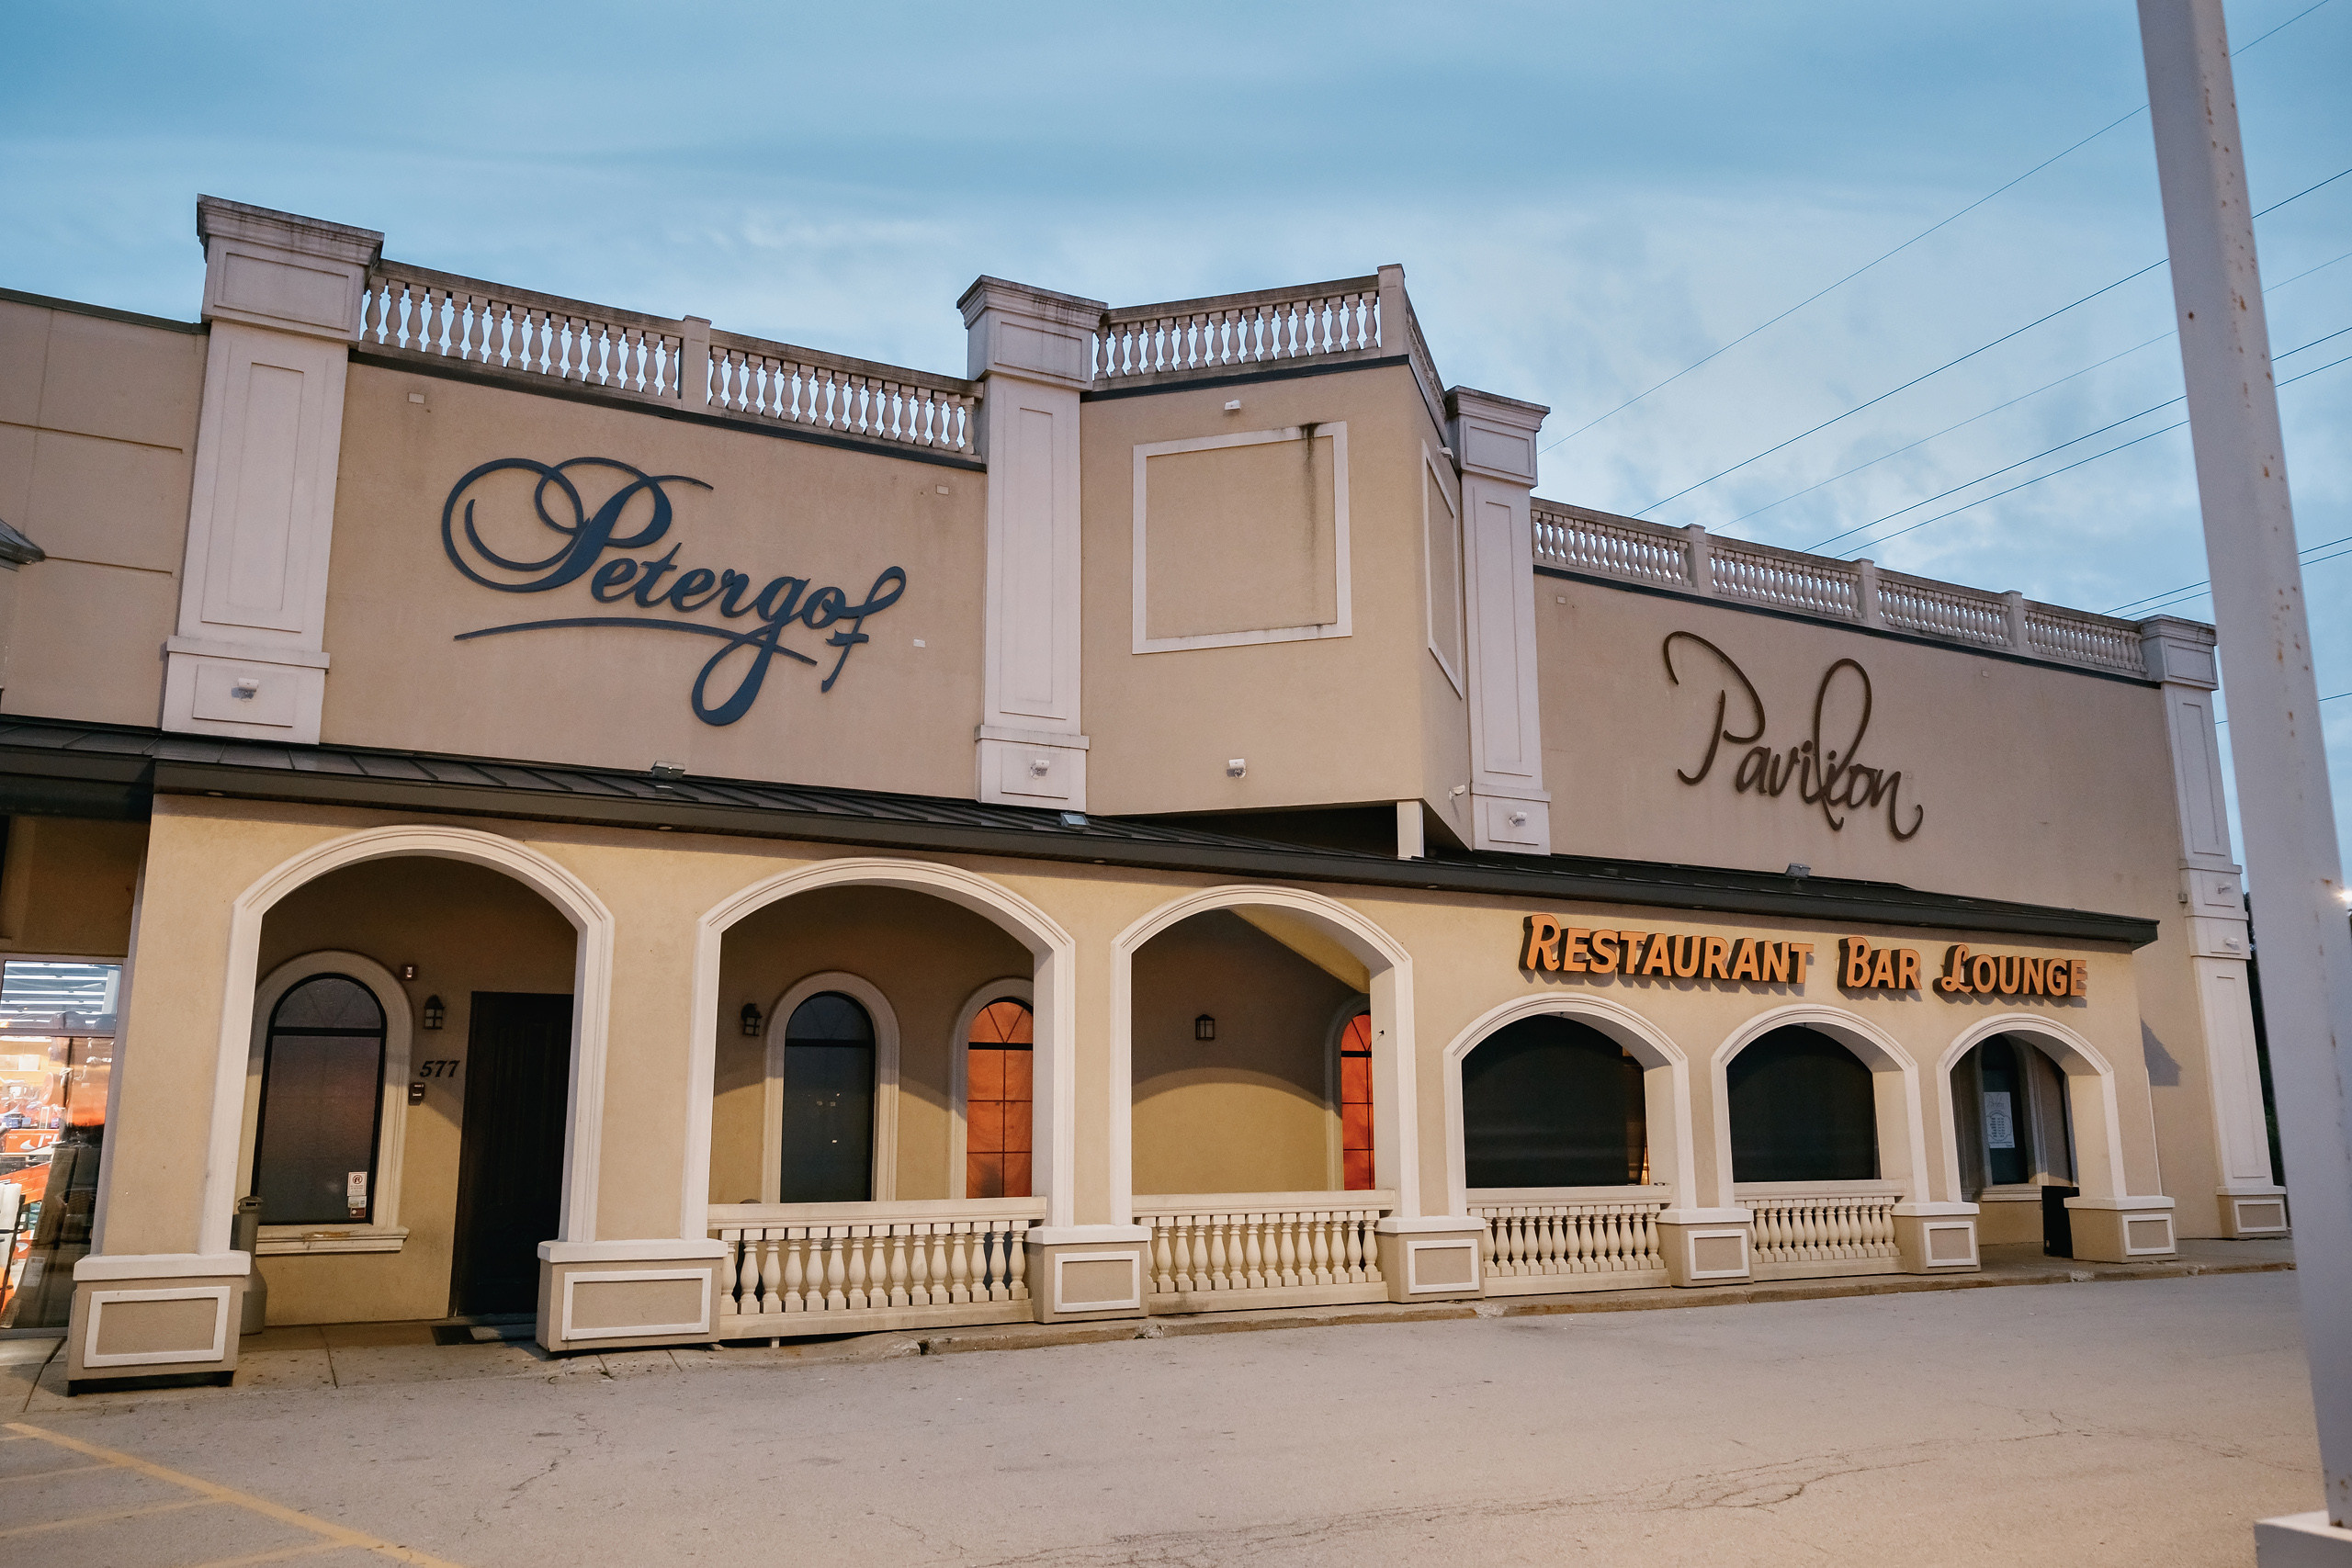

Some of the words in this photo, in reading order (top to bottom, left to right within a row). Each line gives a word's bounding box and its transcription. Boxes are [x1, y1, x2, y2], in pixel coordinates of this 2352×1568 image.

[441, 457, 907, 727] Petergof
[1663, 631, 1924, 841] Pavilion
[1519, 913, 1815, 984] RESTAURANT
[1838, 936, 1923, 990] BAR
[1933, 944, 2087, 998] LOUNGE
[419, 1060, 460, 1077] 577
